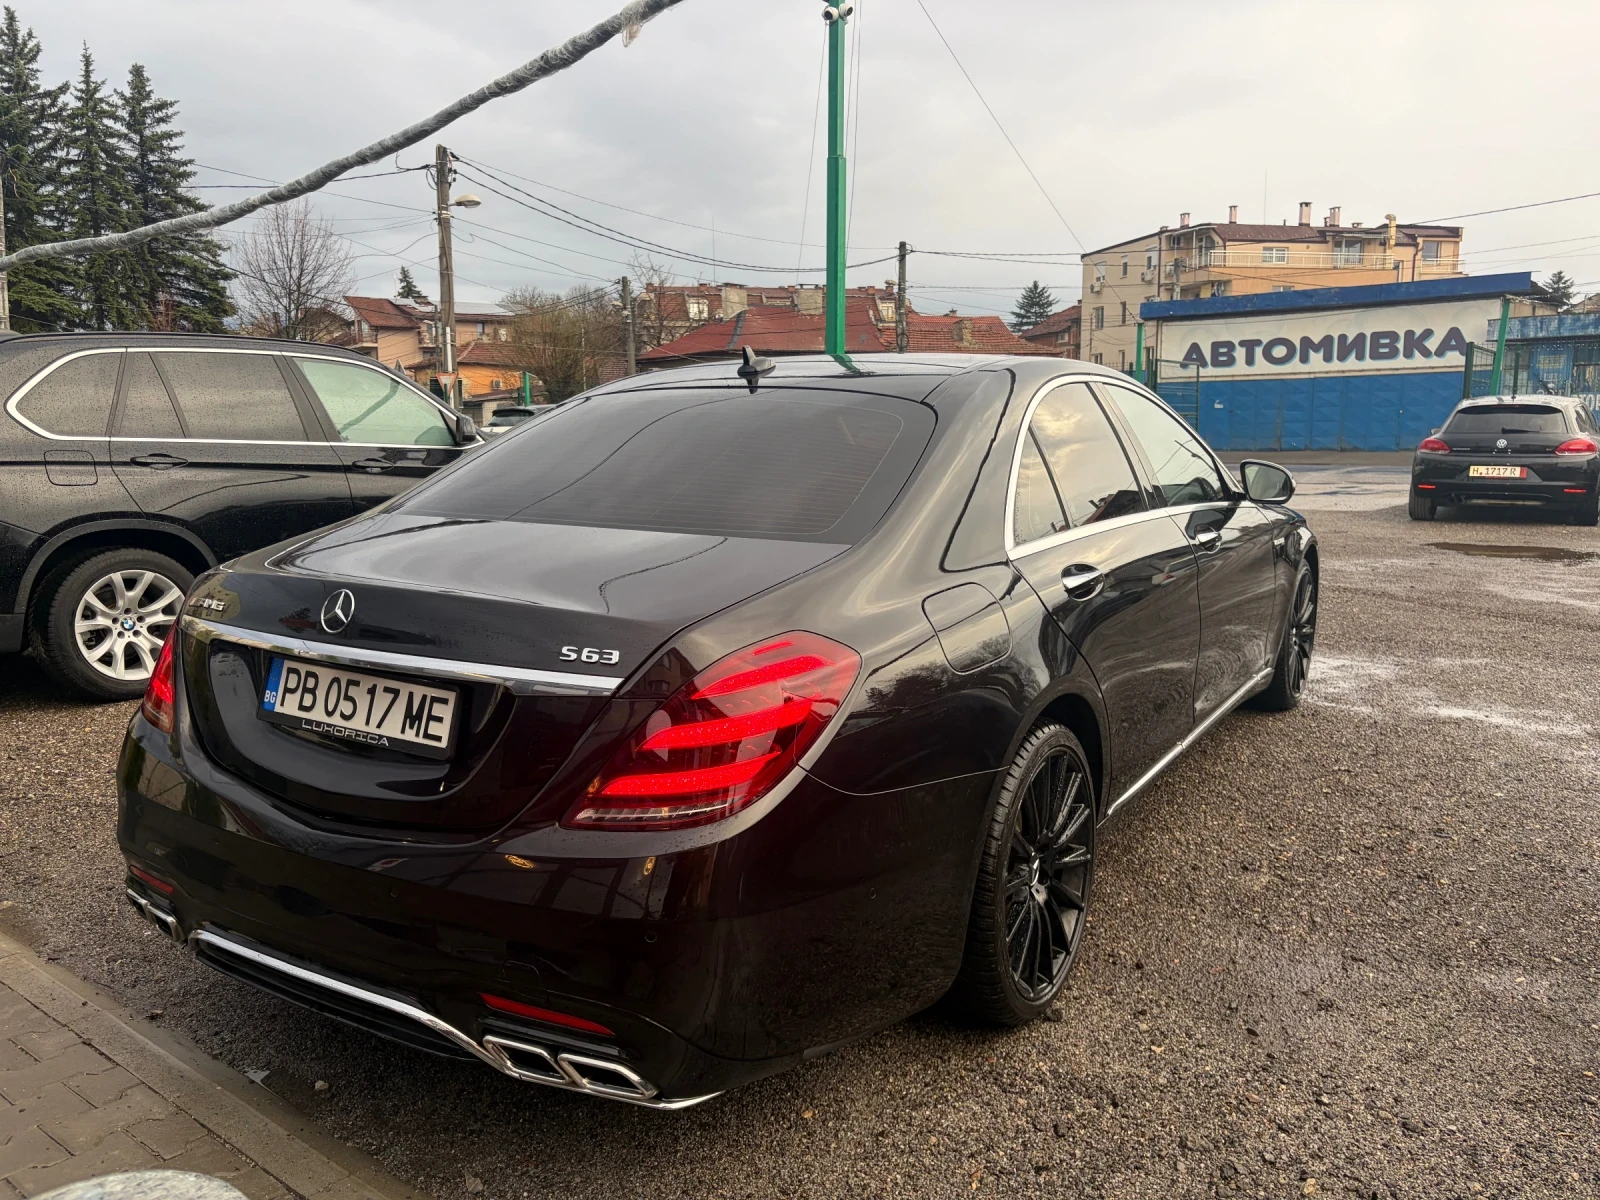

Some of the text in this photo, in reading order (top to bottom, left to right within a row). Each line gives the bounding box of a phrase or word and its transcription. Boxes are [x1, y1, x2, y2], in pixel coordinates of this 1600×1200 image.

[1179, 326, 1467, 369] АВТОМИВКА
[1484, 467, 1508, 475] 1717
[264, 689, 277, 703] BG
[280, 666, 449, 743] PB 0517 ME
[301, 719, 389, 747] LUXORICA
